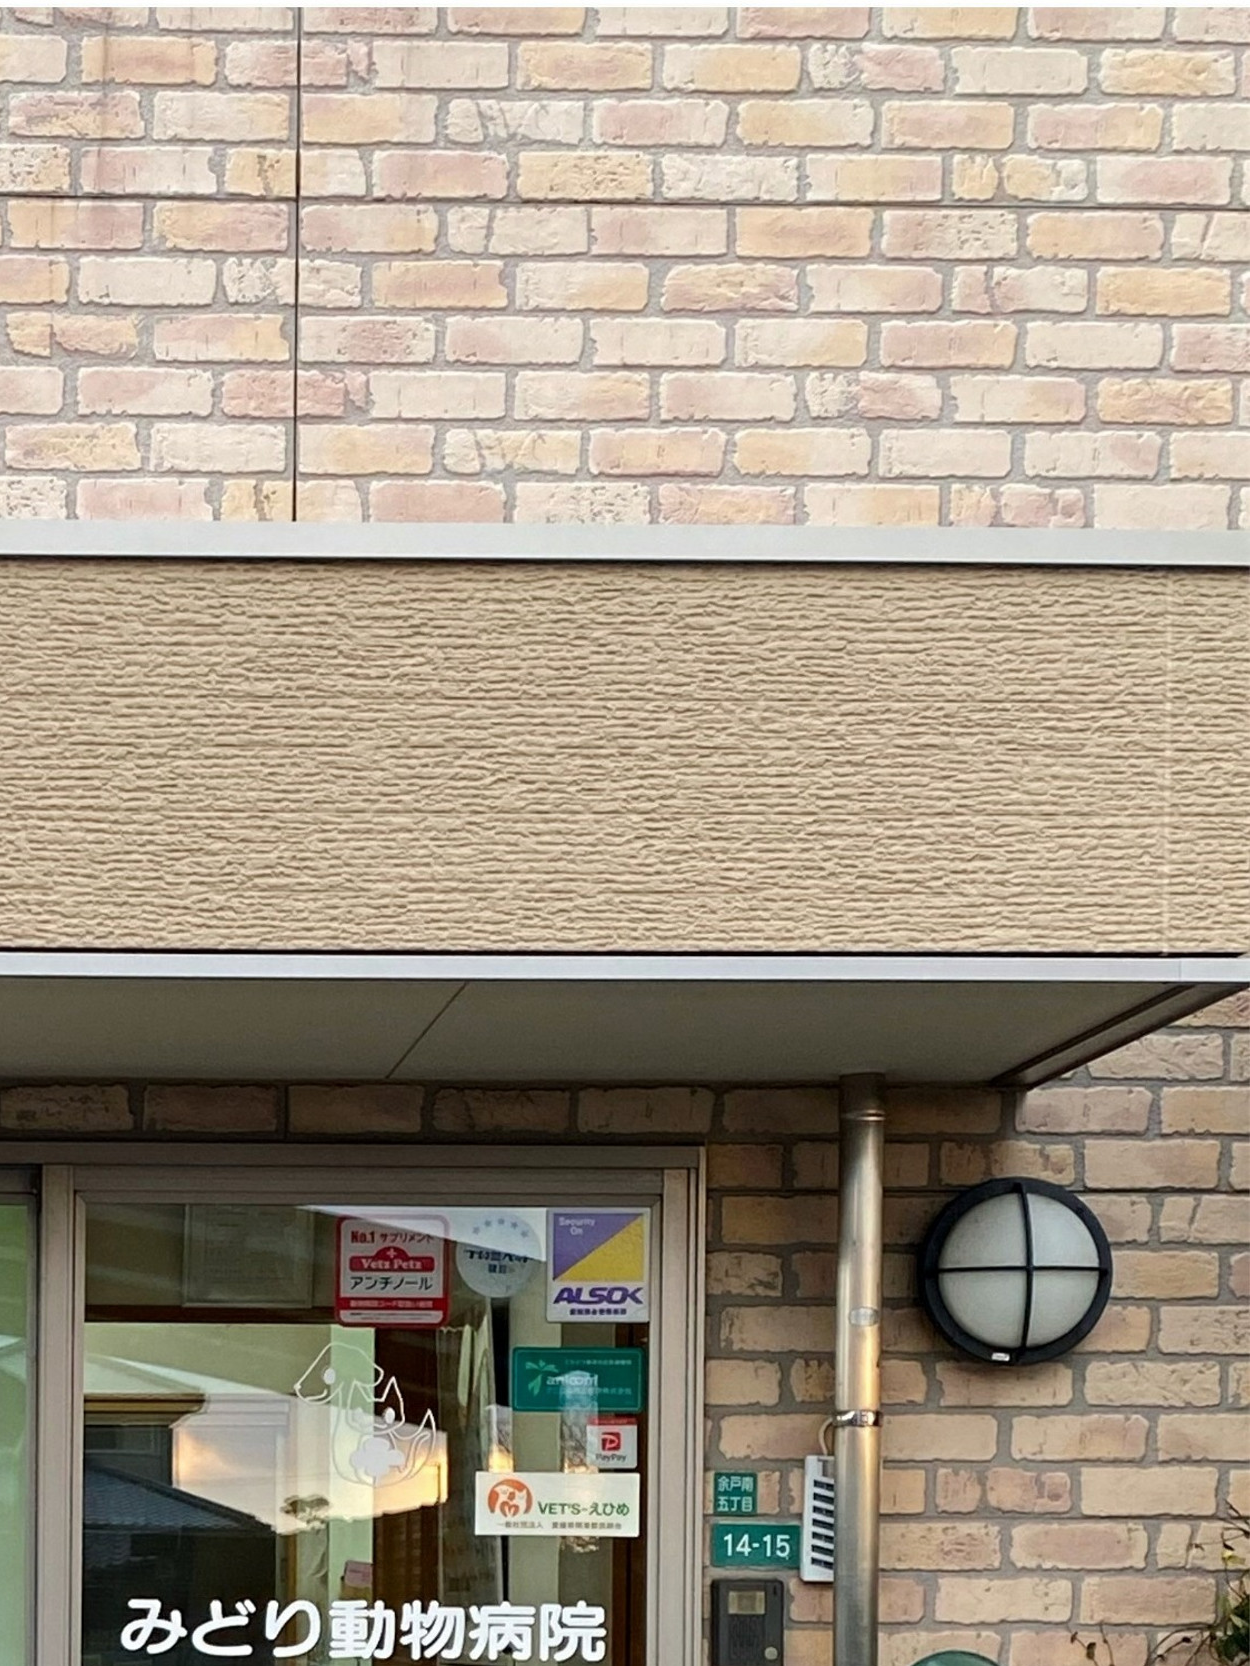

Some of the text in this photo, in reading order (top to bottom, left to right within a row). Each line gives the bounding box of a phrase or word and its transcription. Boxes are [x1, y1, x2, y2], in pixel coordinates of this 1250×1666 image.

[559, 1217, 596, 1228] Security
[351, 1230, 435, 1244] No.1 サプリメント
[570, 1226, 583, 1236] On
[350, 1276, 433, 1291] アンチノール
[553, 1286, 643, 1305] ALSOK
[596, 1453, 627, 1463] PayPay
[717, 1496, 753, 1512] 五丁目
[723, 1533, 791, 1558] 14-15
[119, 1597, 608, 1663] みどり動物病院
